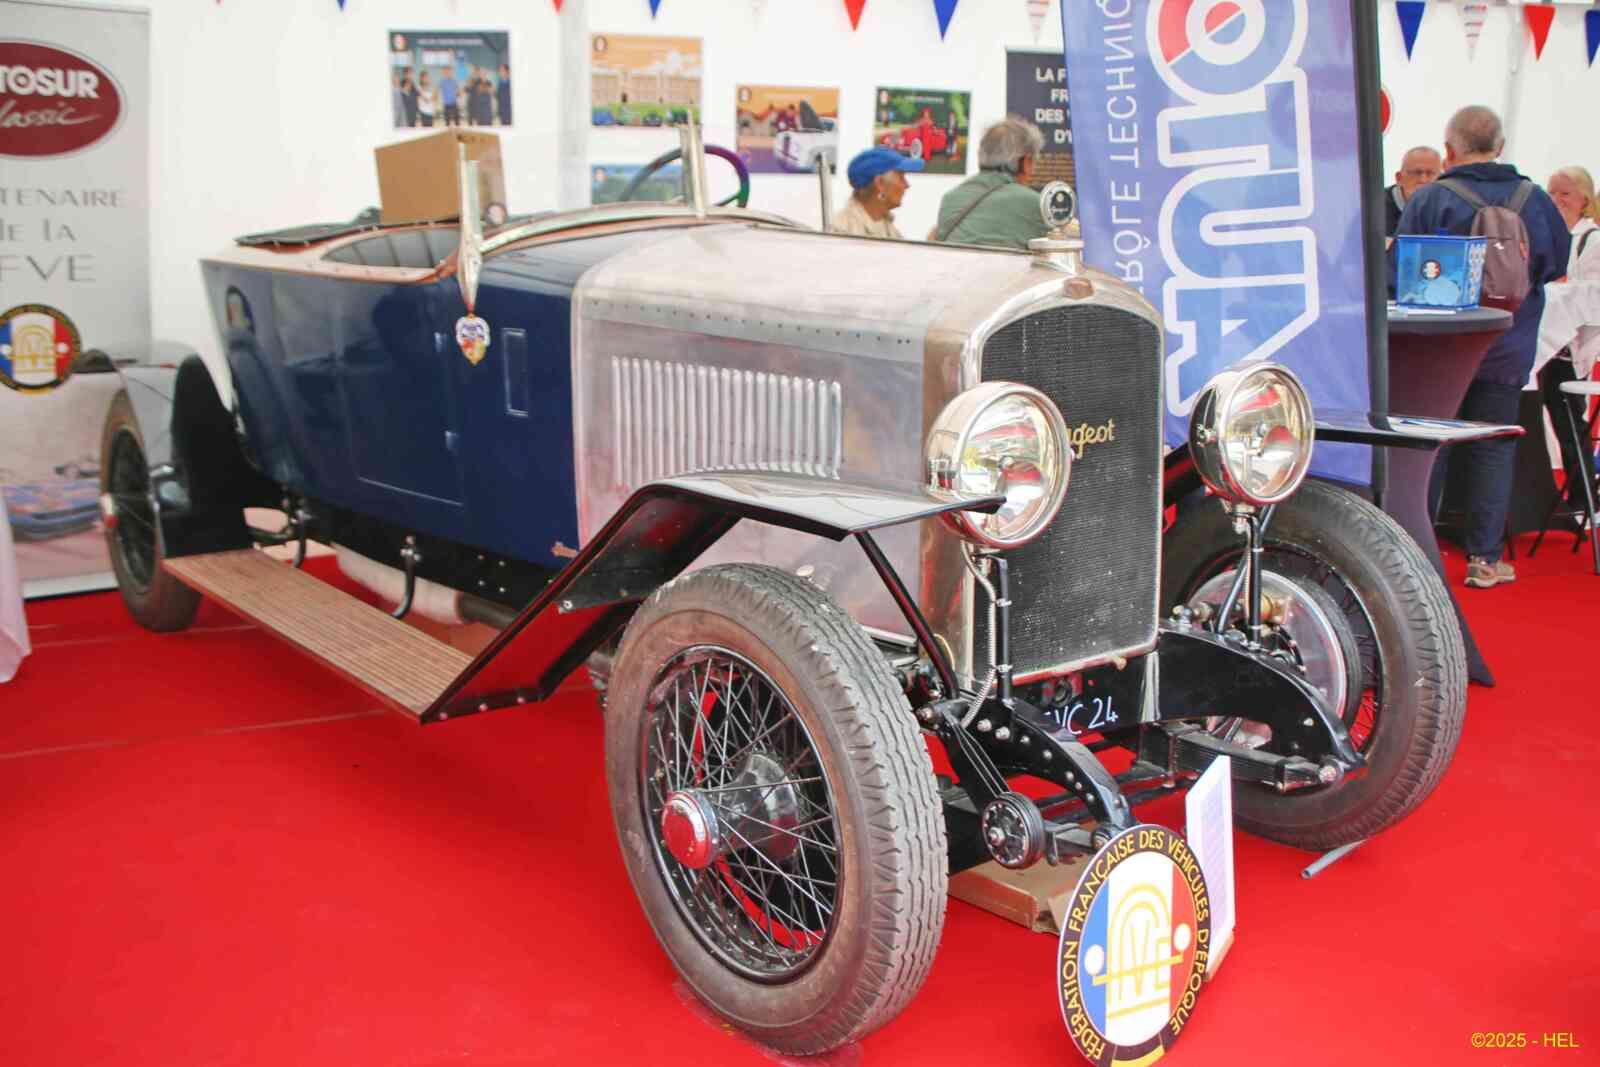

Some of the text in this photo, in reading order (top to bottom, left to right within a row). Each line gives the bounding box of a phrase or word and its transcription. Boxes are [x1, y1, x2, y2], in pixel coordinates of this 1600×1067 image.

[1035, 67, 1055, 82] LA
[1035, 108, 1064, 123] DES
[1088, 696, 1119, 729] 24
[1139, 829, 1165, 850] DES
[1069, 838, 1135, 933] FRANÇAISE
[1168, 839, 1209, 922] VÉHICULES
[1063, 940, 1106, 1060] FÉDÉRATION
